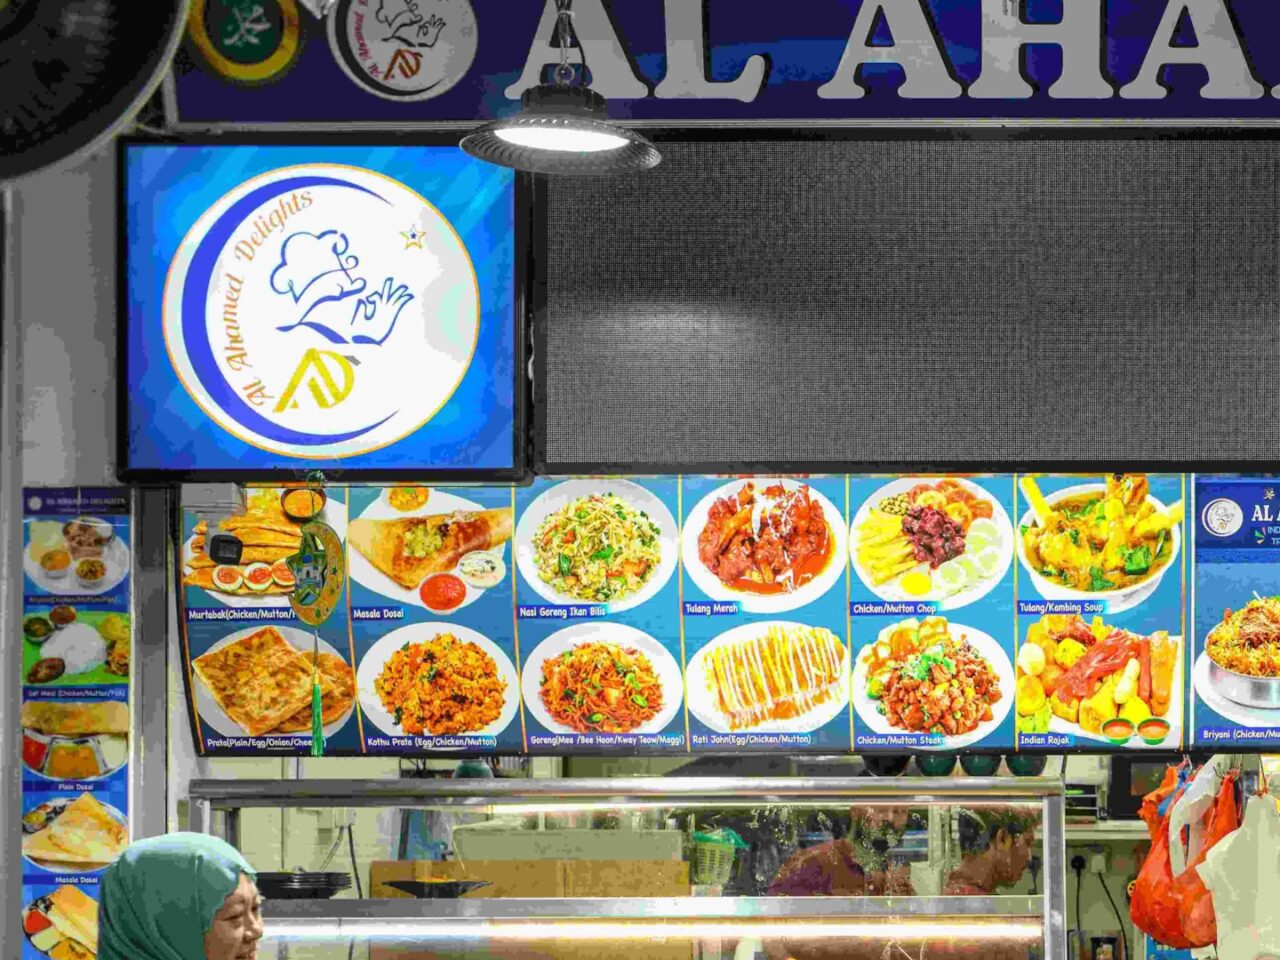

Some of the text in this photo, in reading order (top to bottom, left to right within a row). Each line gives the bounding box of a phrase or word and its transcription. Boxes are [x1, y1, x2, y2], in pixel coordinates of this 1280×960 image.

[503, 0, 771, 103] AL
[234, 190, 314, 262] Delights
[223, 273, 253, 372] Ahamed
[1251, 504, 1273, 522] AL
[353, 608, 381, 619] Masala
[519, 605, 606, 619] Nasi Goreng Ikan Bilis
[685, 602, 738, 615] Tulang Merah
[853, 602, 937, 615] Chicken/Mutton Chop
[1019, 602, 1104, 614] Tulang/Kambing Soup
[857, 735, 943, 745] Chicken/Mutton Steak
[1203, 729, 1231, 740] Briyani
[367, 738, 497, 748] Kothu Prata (Egg/Chicken/Mutton)
[692, 735, 812, 746] Roti John(Egg/Chicken/Mutton)
[1020, 736, 1070, 746] Indian Rojak
[58, 783, 76, 791] Plain
[55, 876, 78, 884] Masala
